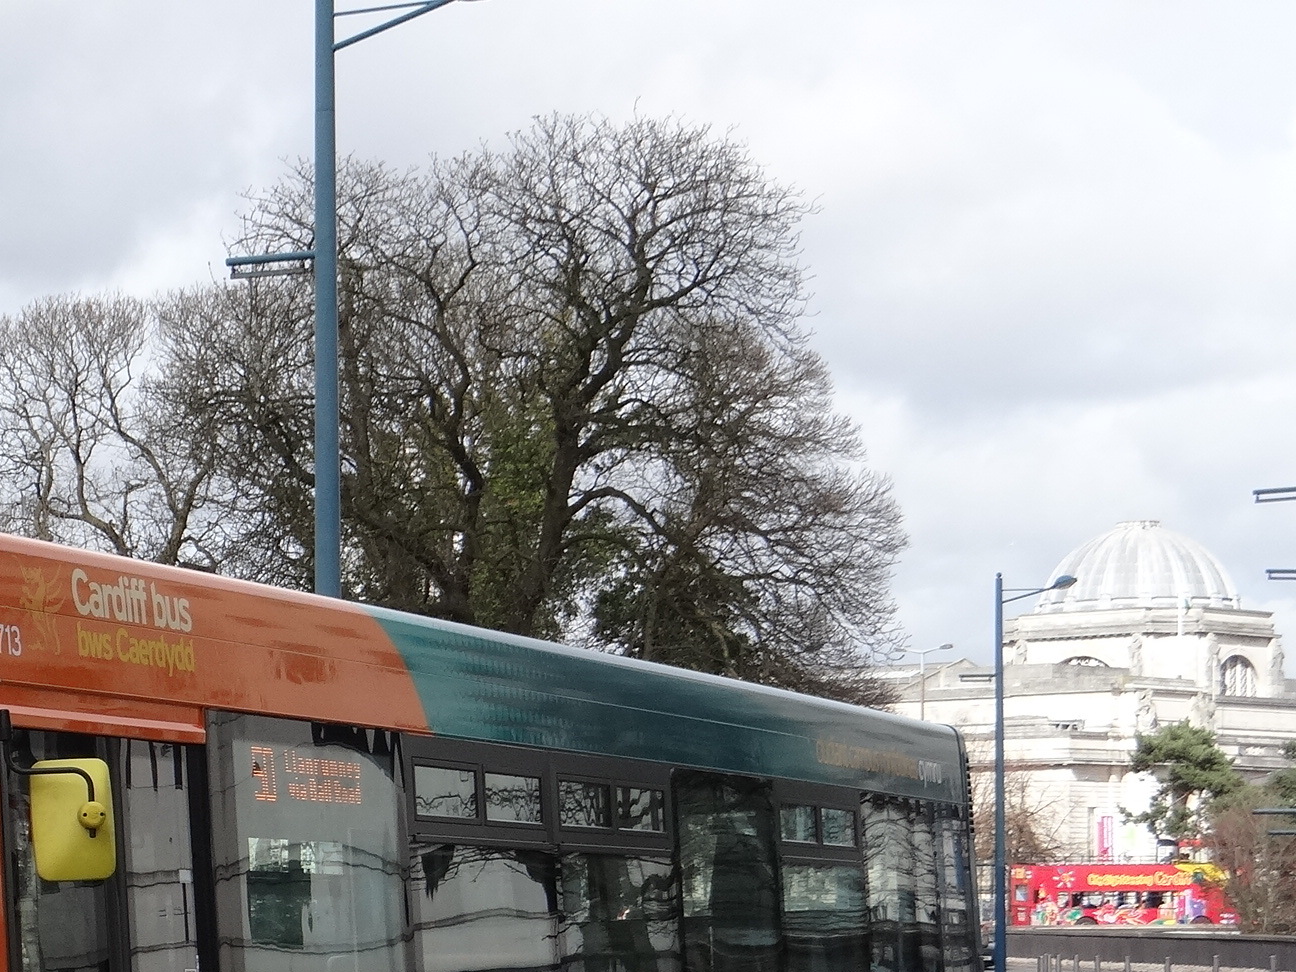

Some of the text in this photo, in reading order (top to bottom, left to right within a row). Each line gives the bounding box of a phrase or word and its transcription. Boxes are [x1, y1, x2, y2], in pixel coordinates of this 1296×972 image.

[71, 567, 193, 633] Cardiff bus
[75, 620, 195, 677] bws Caerdydd
